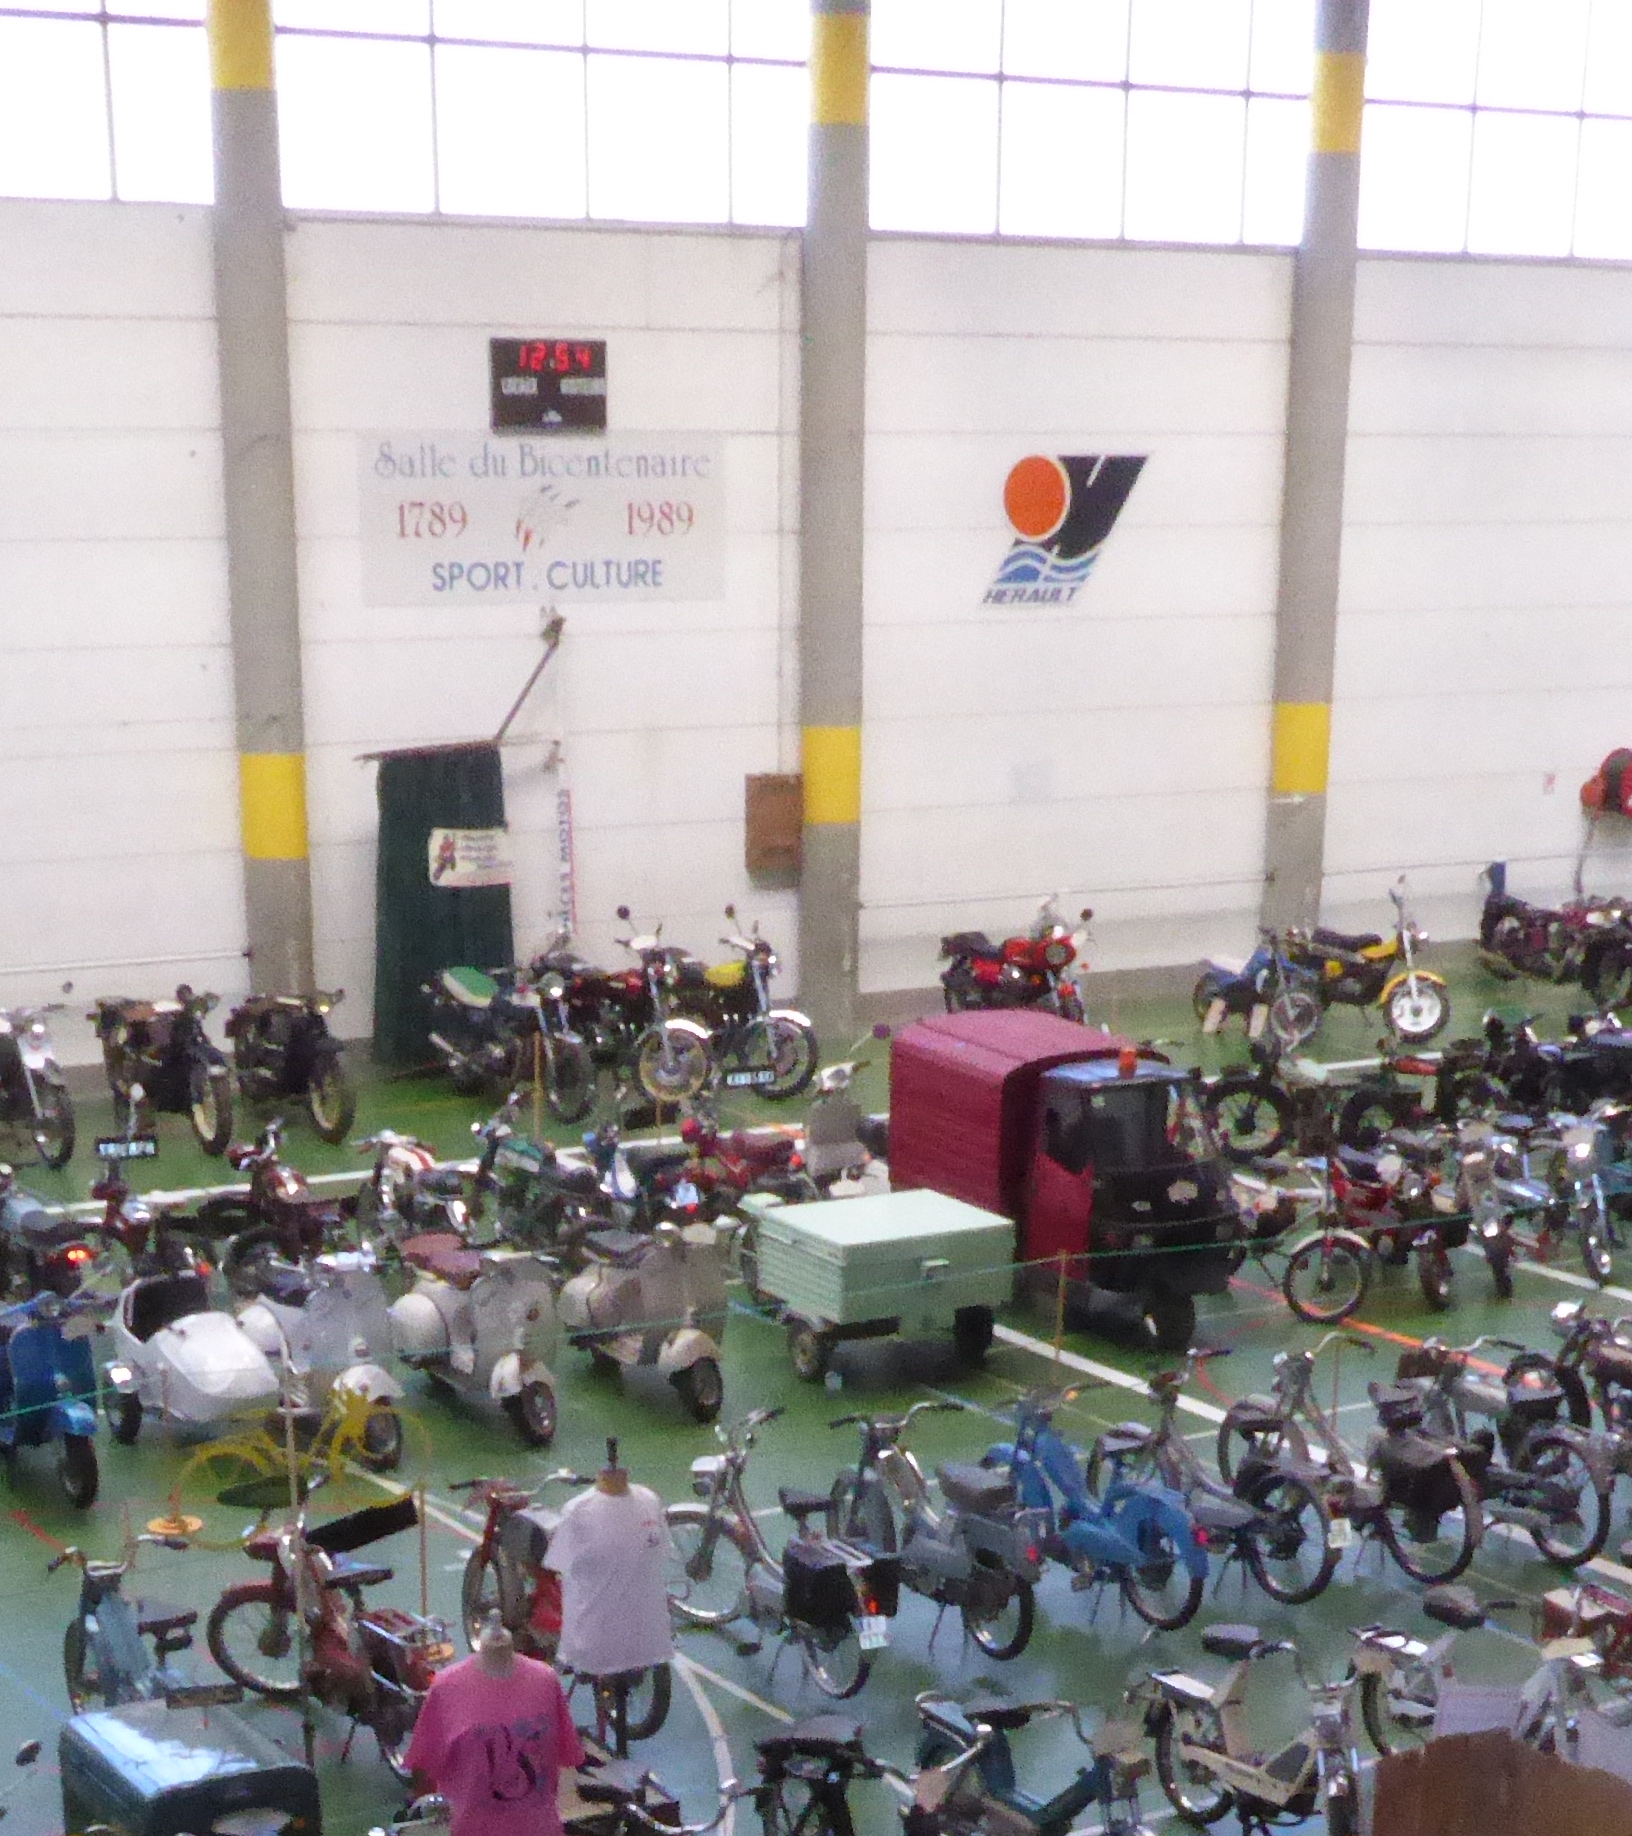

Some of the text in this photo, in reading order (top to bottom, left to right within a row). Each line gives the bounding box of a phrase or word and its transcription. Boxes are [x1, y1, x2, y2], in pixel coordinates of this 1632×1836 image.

[373, 441, 711, 479] Salle du Bicentenaire
[397, 501, 695, 538] 1789 1989
[431, 558, 664, 592] SPORT CULTURE
